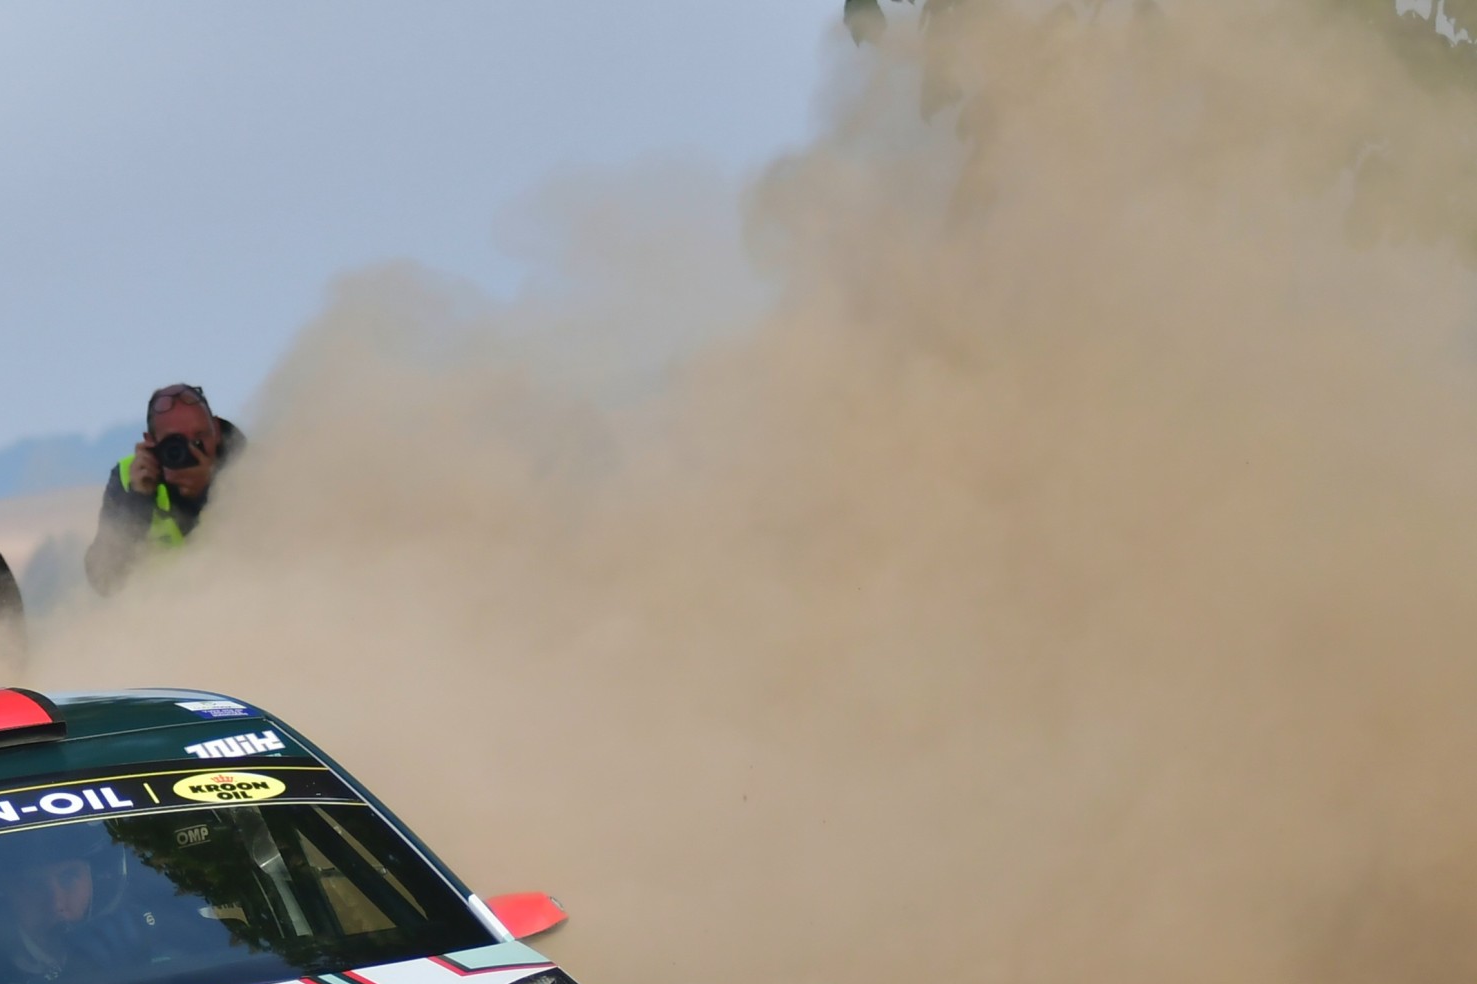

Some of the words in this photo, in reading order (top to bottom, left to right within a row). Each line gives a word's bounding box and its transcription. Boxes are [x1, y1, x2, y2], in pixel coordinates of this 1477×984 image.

[189, 781, 270, 794] KROON
[216, 790, 253, 800] OIL
[176, 826, 209, 846] OMP
